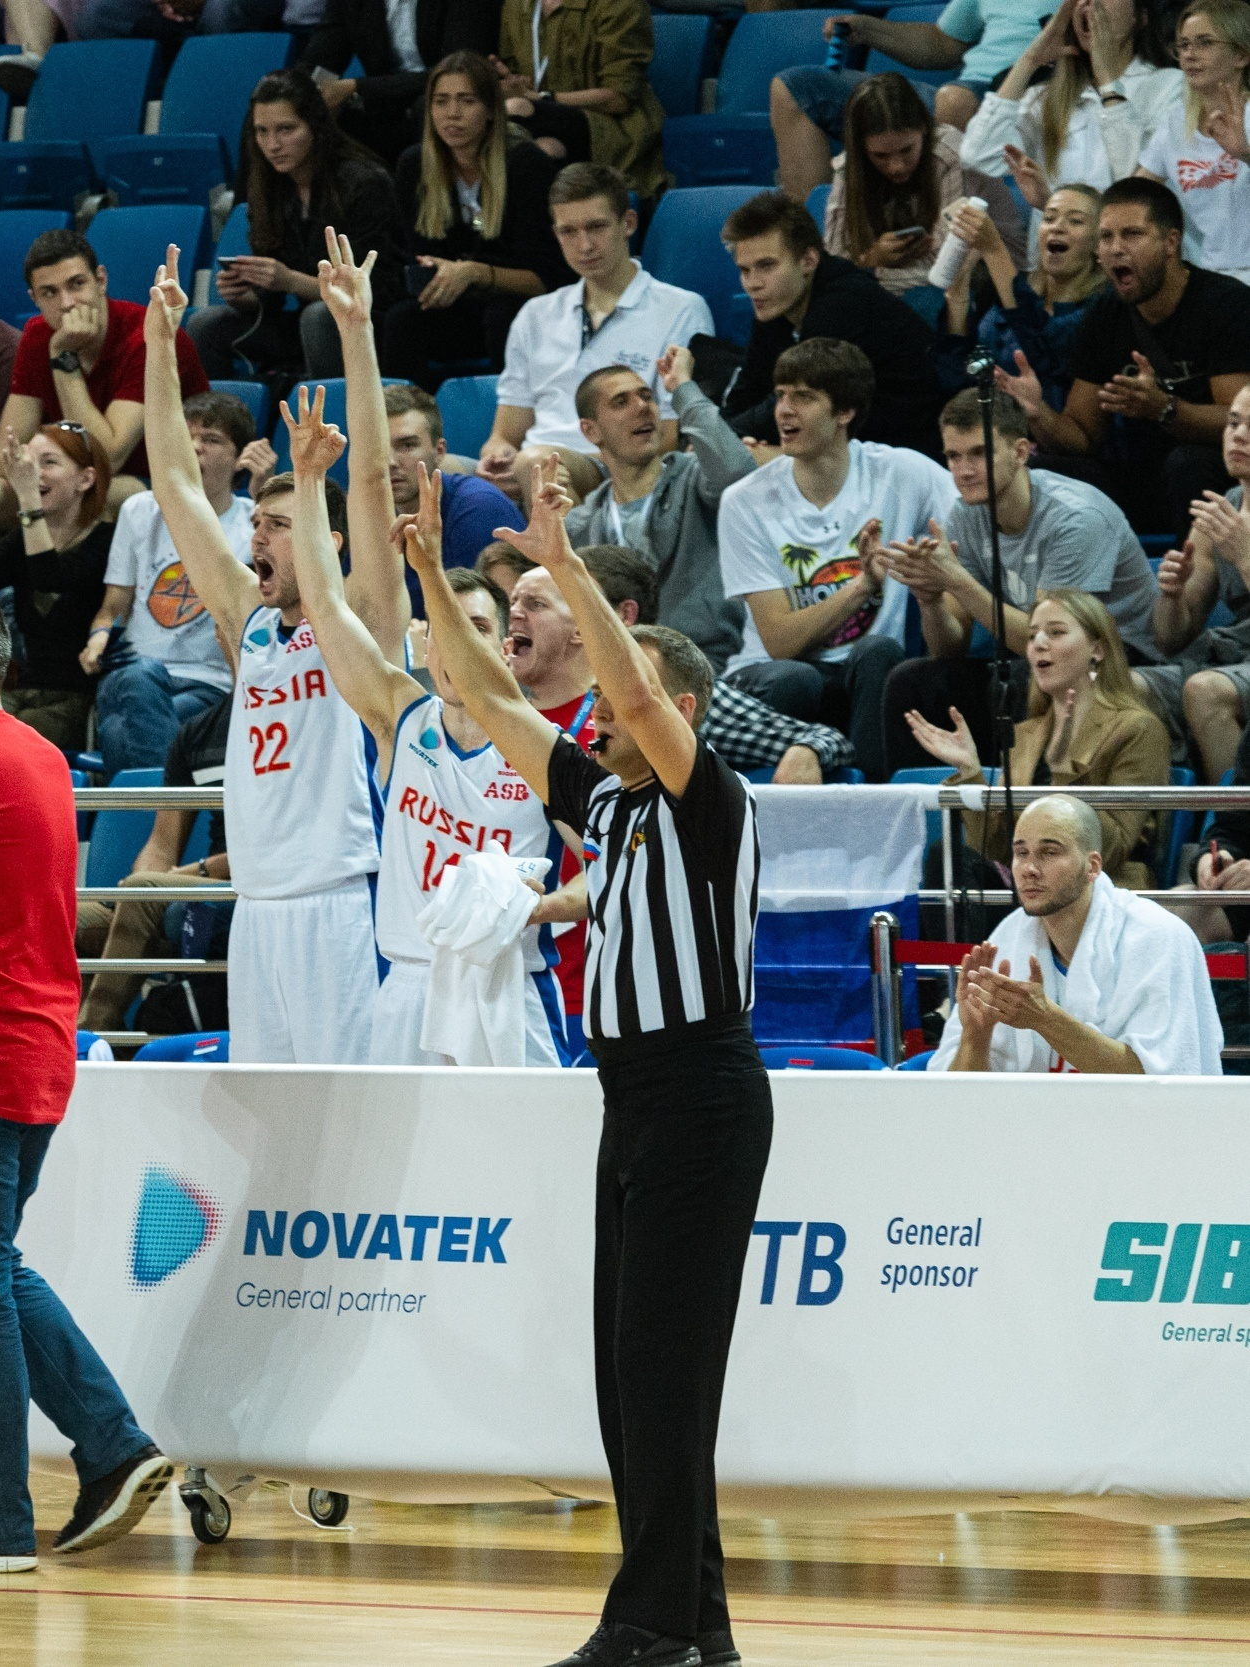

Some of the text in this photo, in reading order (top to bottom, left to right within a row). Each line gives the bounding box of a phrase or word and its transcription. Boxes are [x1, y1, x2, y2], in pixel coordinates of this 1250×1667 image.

[242, 669, 326, 709] SSIA
[249, 721, 291, 776] 22
[399, 786, 513, 856] RUSSIA
[243, 1209, 513, 1264] NOVATEK
[886, 1216, 982, 1247] General
[880, 1264, 979, 1293] sponsor
[236, 1282, 426, 1316] General partner
[1161, 1321, 1232, 1342] General
